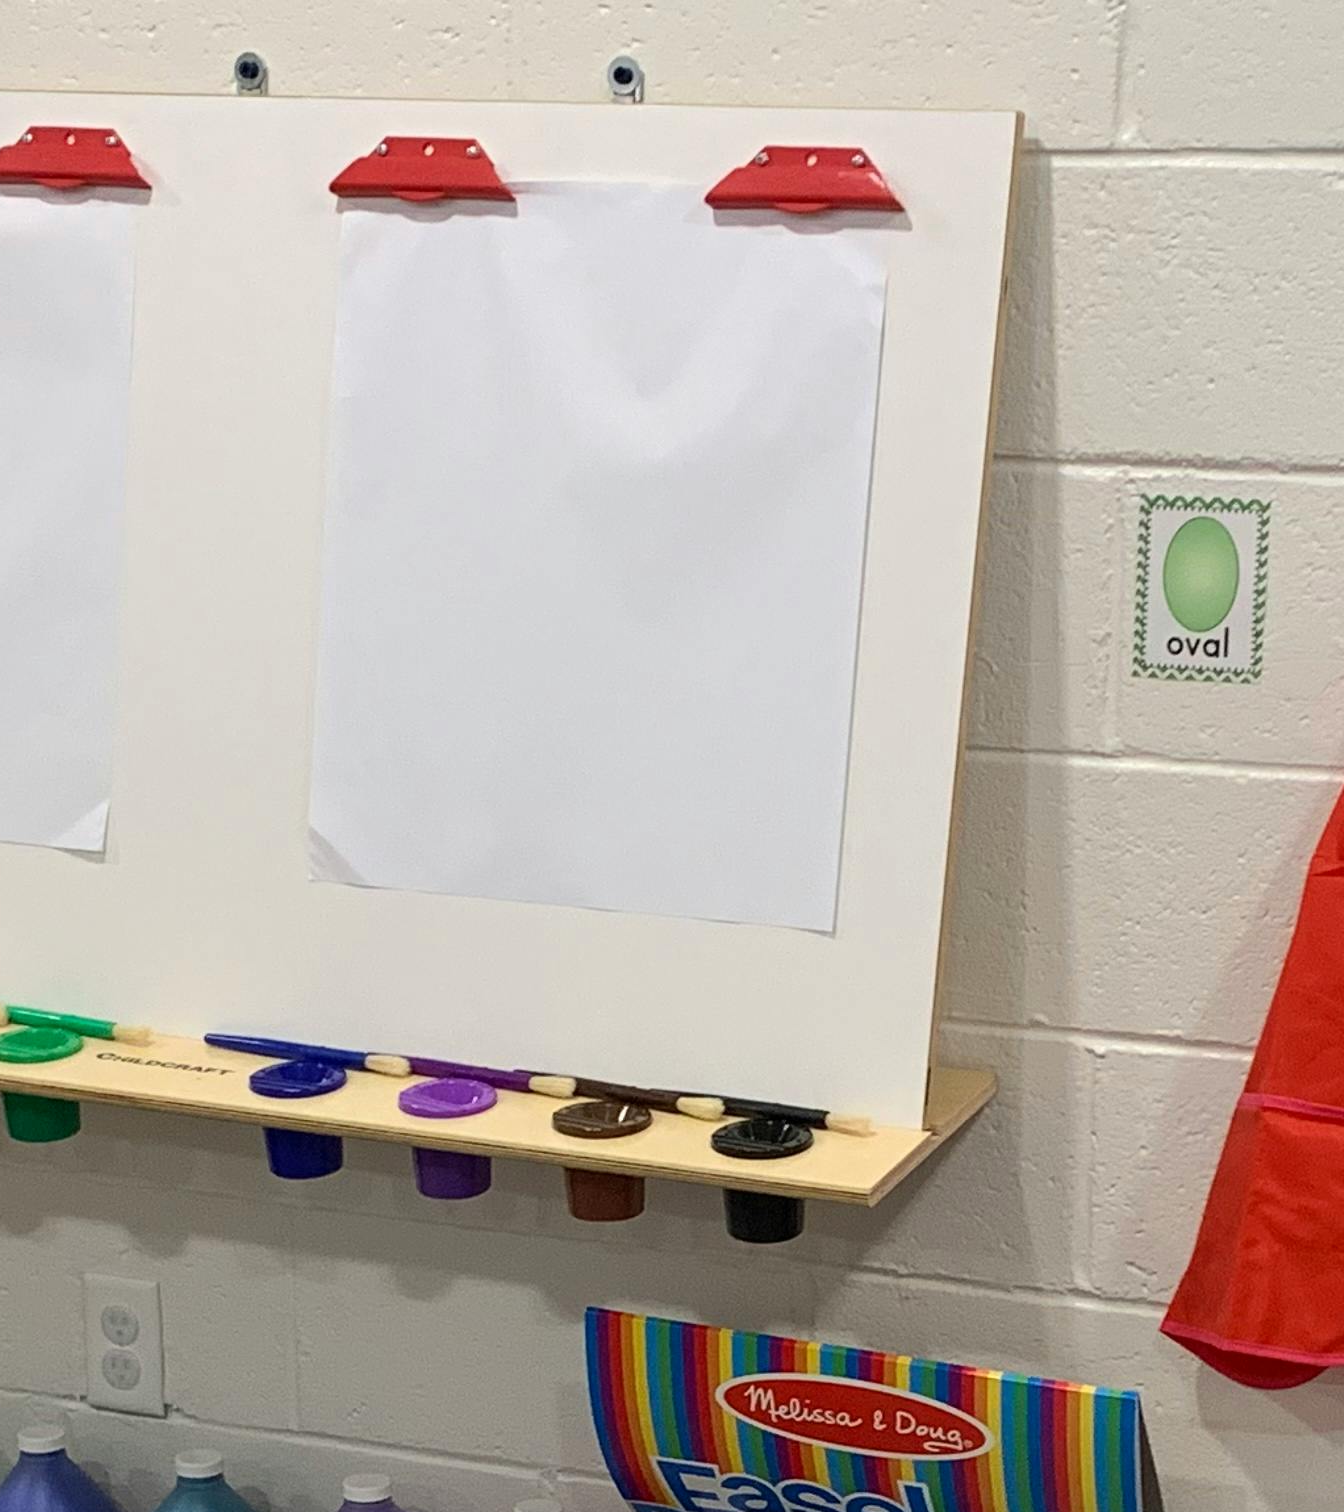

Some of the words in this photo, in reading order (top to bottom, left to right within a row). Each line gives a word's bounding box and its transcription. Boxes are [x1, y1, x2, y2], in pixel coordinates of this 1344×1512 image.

[1167, 626, 1230, 658] oval
[744, 1385, 862, 1427] Melissa
[873, 1410, 887, 1430] &
